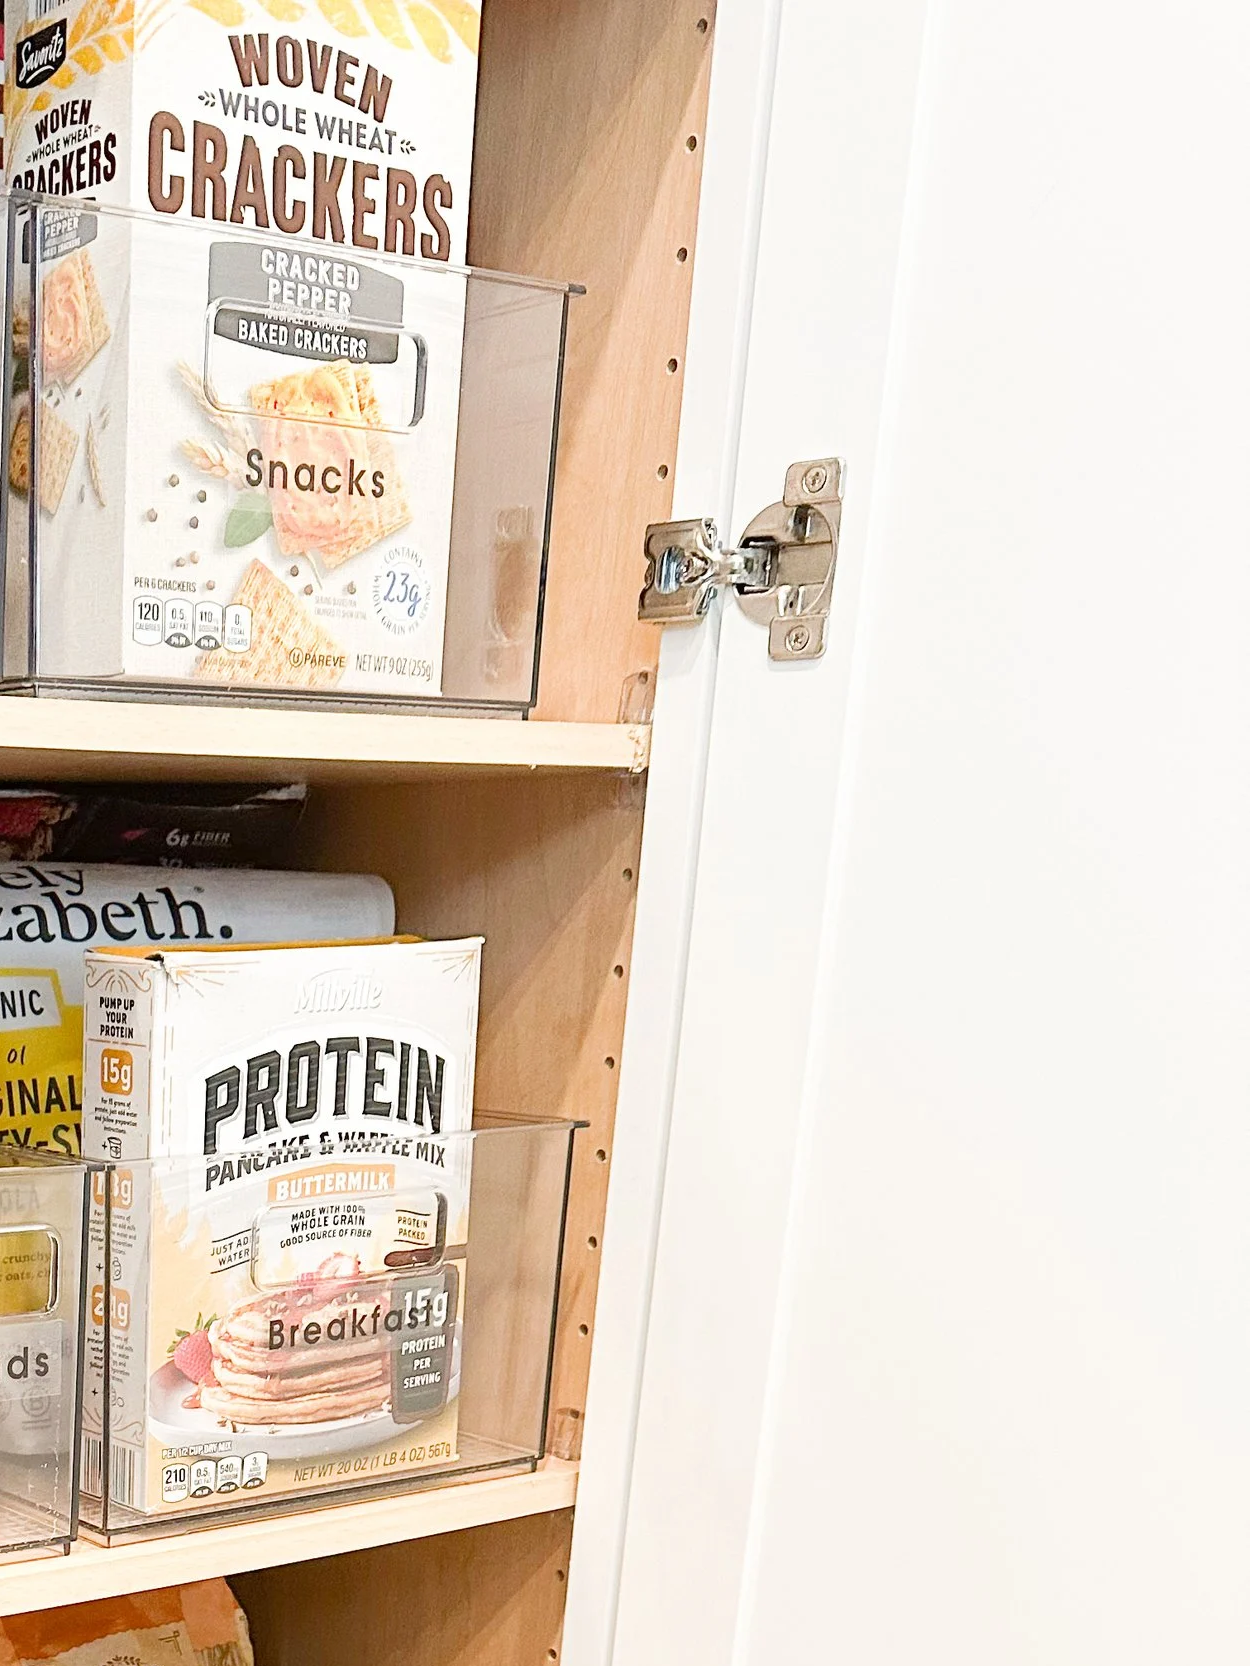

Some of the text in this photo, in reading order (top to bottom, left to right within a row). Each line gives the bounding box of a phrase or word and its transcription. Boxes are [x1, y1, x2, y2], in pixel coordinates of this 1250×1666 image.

[228, 34, 392, 122] WOVEN
[35, 100, 92, 145] WOVEN
[218, 88, 398, 155] WHOLE WHEAT
[32, 125, 93, 162] WHOLE WHEAT
[12, 132, 116, 196] CRACKERS
[148, 111, 453, 262] CRACKERS
[44, 217, 79, 240] PEPPER
[261, 248, 360, 291] CRACKED
[268, 278, 352, 316] PEPPER
[238, 319, 368, 359] BAKED CRACKERS
[245, 448, 385, 498] Snacks
[383, 570, 423, 617] 23g
[138, 603, 159, 621] 120
[304, 652, 346, 668] PAREVE
[100, 997, 135, 1012] PUMP UP
[293, 973, 384, 1015] Millville
[100, 1024, 134, 1039] PROTEIN
[106, 1012, 127, 1025] YOUR
[102, 1056, 131, 1092] 15g
[203, 1037, 445, 1157] PROTEIN
[206, 1134, 311, 1192] PANCAKE
[319, 1131, 334, 1155] &
[415, 1141, 446, 1168] MIX
[276, 1170, 391, 1201] BUTTERMILK
[291, 1210, 316, 1222] MADE
[318, 1206, 341, 1214] WITH
[291, 1214, 365, 1234] WHOLE GRAIN
[397, 1216, 428, 1228] PROTEIN
[211, 1242, 234, 1257] JUST
[280, 1229, 372, 1249] GOOD SOURCE OF FIBER
[398, 1227, 426, 1241] PACKED
[219, 1249, 250, 1266] WATER
[268, 1304, 436, 1351] Breakfast
[401, 1335, 446, 1356] PROTEIN
[413, 1356, 431, 1371] PER
[403, 1371, 441, 1389] SERVING
[165, 1468, 186, 1484] 210
[294, 1467, 316, 1482] NET
[317, 1465, 336, 1478] WT
[337, 1462, 351, 1475] 20
[353, 1459, 368, 1472] OZ
[382, 1453, 398, 1467] LB
[400, 1452, 407, 1464] 4
[409, 1448, 426, 1462] OZ)
[428, 1442, 450, 1459] 567g
